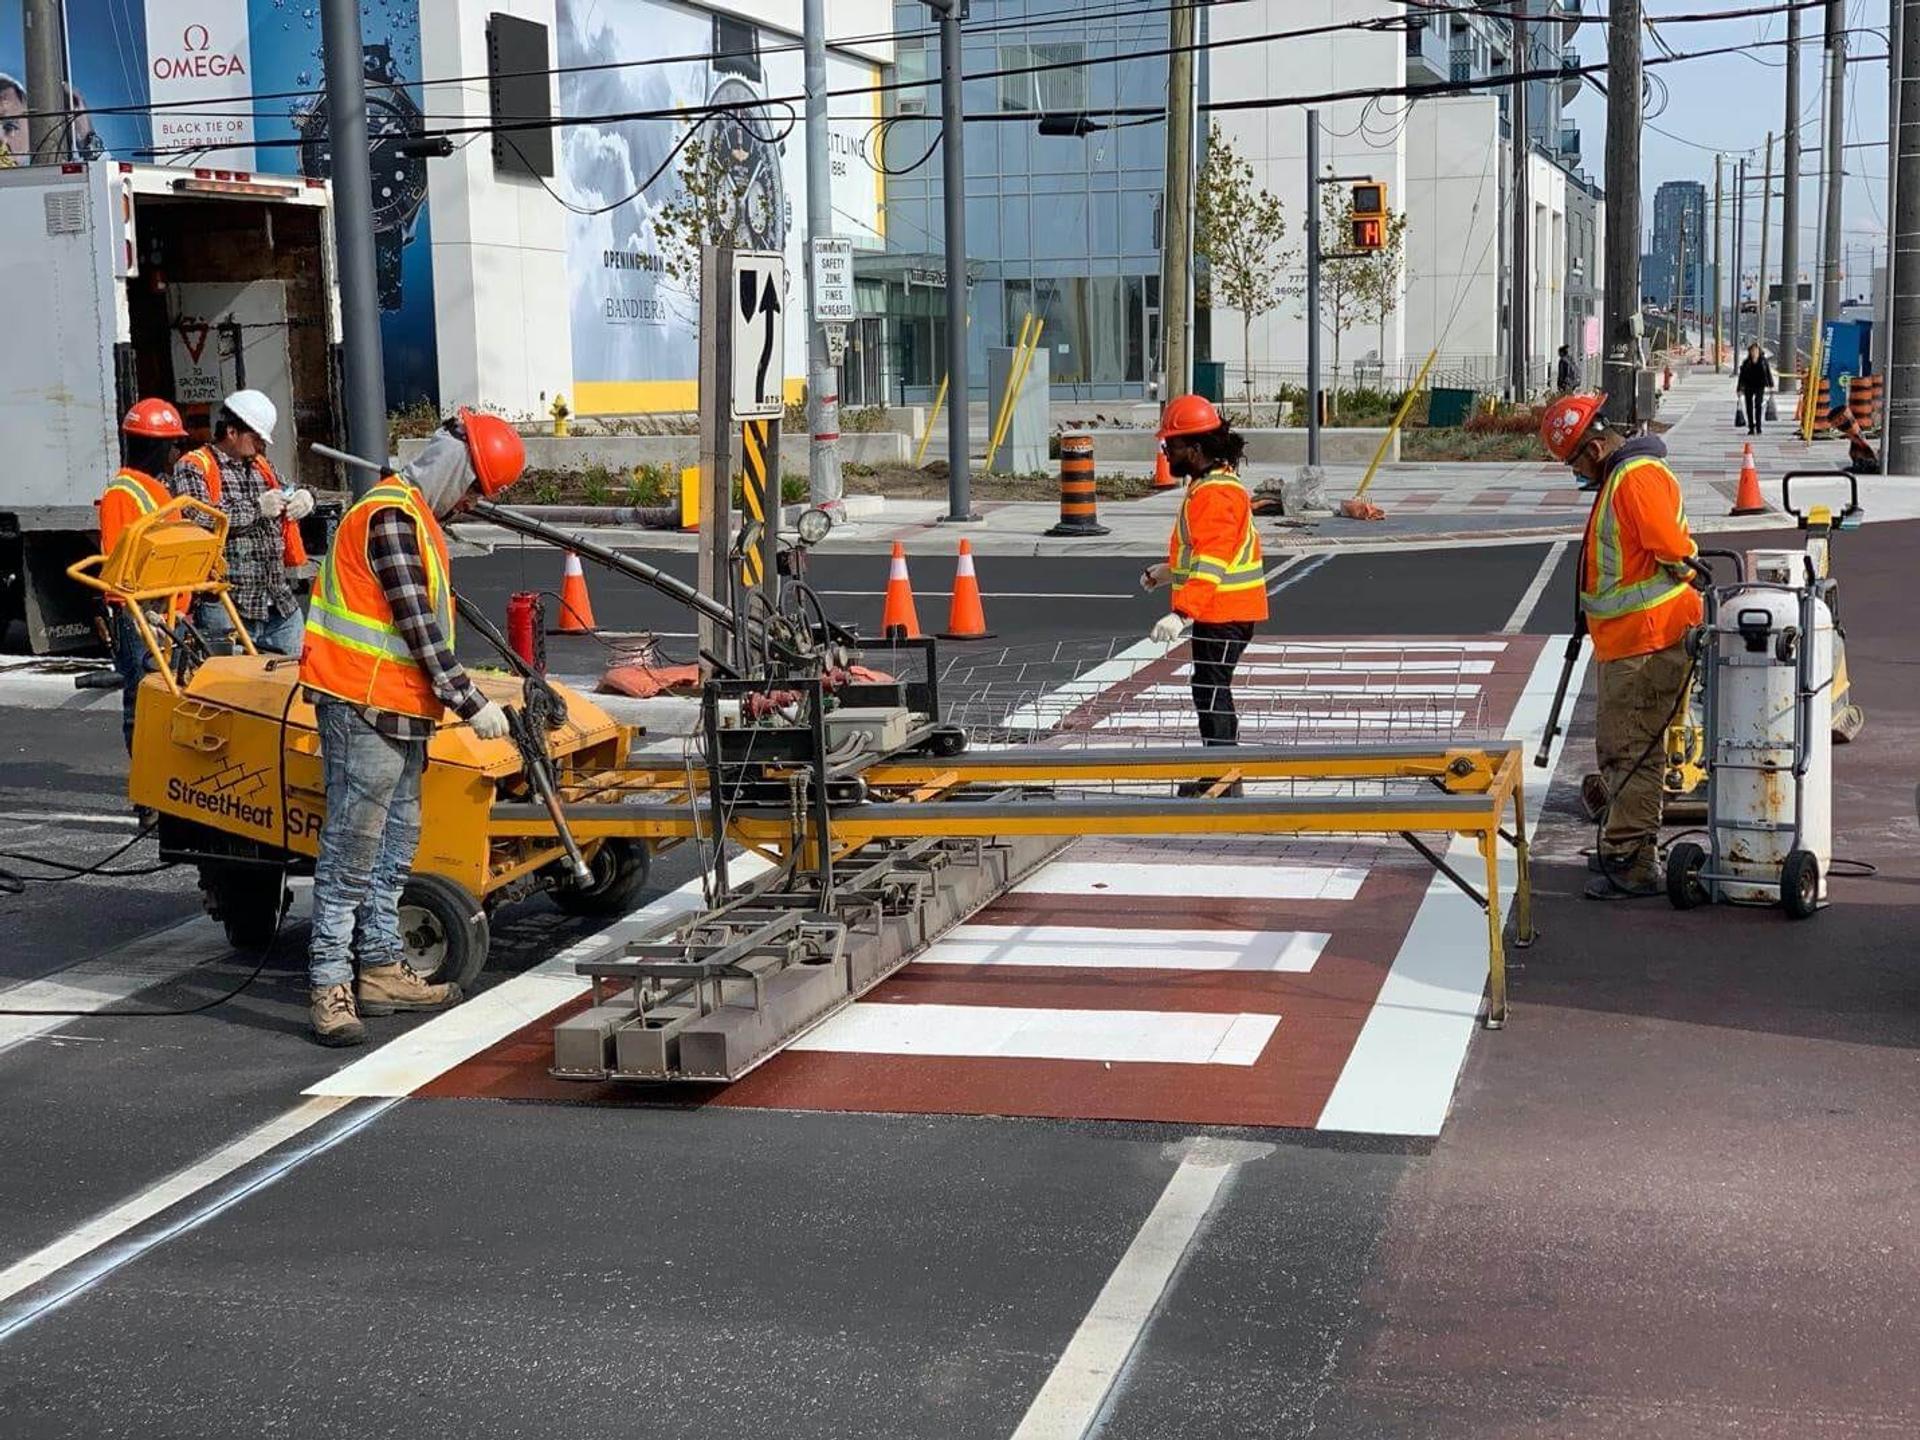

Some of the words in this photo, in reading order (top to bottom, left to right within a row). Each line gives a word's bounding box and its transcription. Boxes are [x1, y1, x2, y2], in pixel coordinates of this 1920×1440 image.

[153, 54, 246, 79] OMEGA
[162, 123, 202, 134] BLACK
[206, 121, 223, 132] TIE
[226, 120, 244, 132] OR
[815, 242, 850, 254] COMMUNITY
[603, 249, 641, 271] OPENING
[821, 257, 845, 269] SAFETY
[825, 273, 842, 284] ZONE
[825, 290, 843, 301] FINES
[606, 297, 666, 320] BANDIERA
[817, 304, 851, 315] INCREASED
[830, 336, 843, 352] 56
[167, 777, 274, 829] StreetHeat
